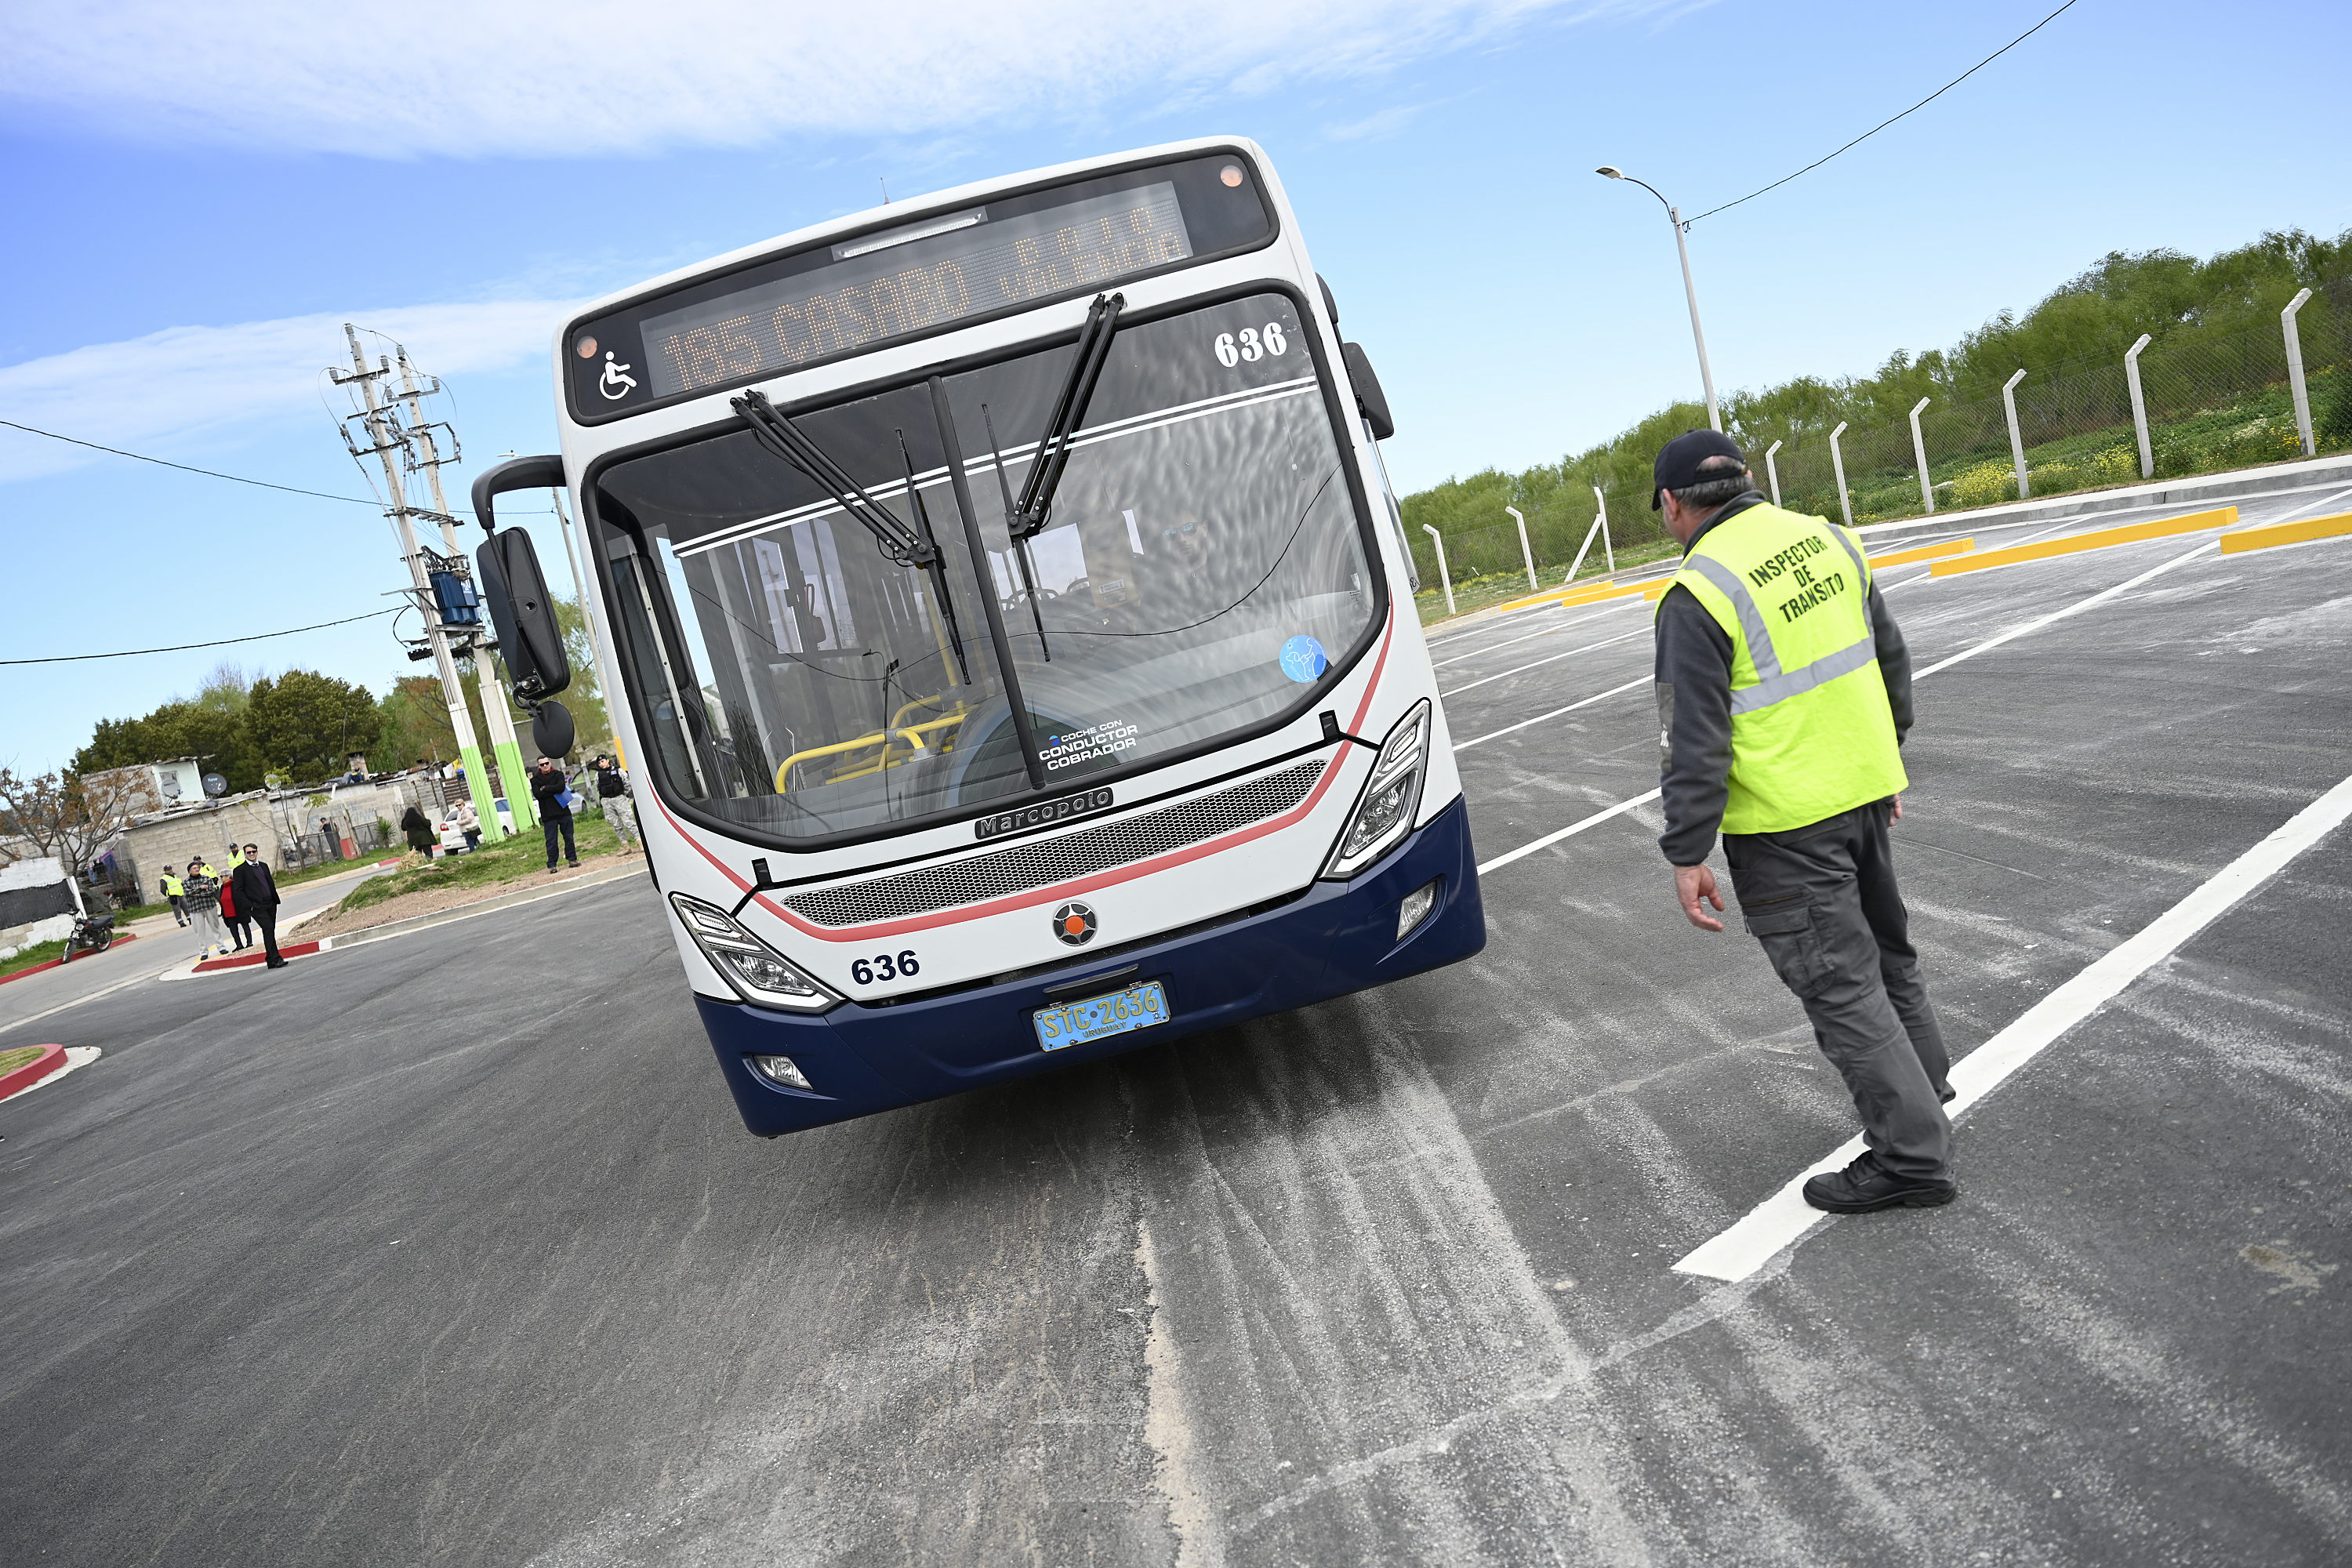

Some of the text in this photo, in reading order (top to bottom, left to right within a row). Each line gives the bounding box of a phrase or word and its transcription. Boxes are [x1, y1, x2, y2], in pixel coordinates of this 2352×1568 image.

[664, 259, 970, 391] 185 CASABO
[1214, 321, 1287, 368] 636
[1748, 535, 1828, 588] INSPECTOR
[1792, 564, 1815, 588] DE
[1779, 572, 1845, 623] TRANSITO
[1039, 724, 1138, 760] CONDUCTOR
[1060, 719, 1123, 742] COCHE CON
[1047, 737, 1137, 771] COBRADOR
[980, 791, 1109, 837] Marcopolo
[851, 949, 920, 985] 636
[1043, 989, 1159, 1038] STC 2636
[1083, 1021, 1127, 1038] URUGUAY
